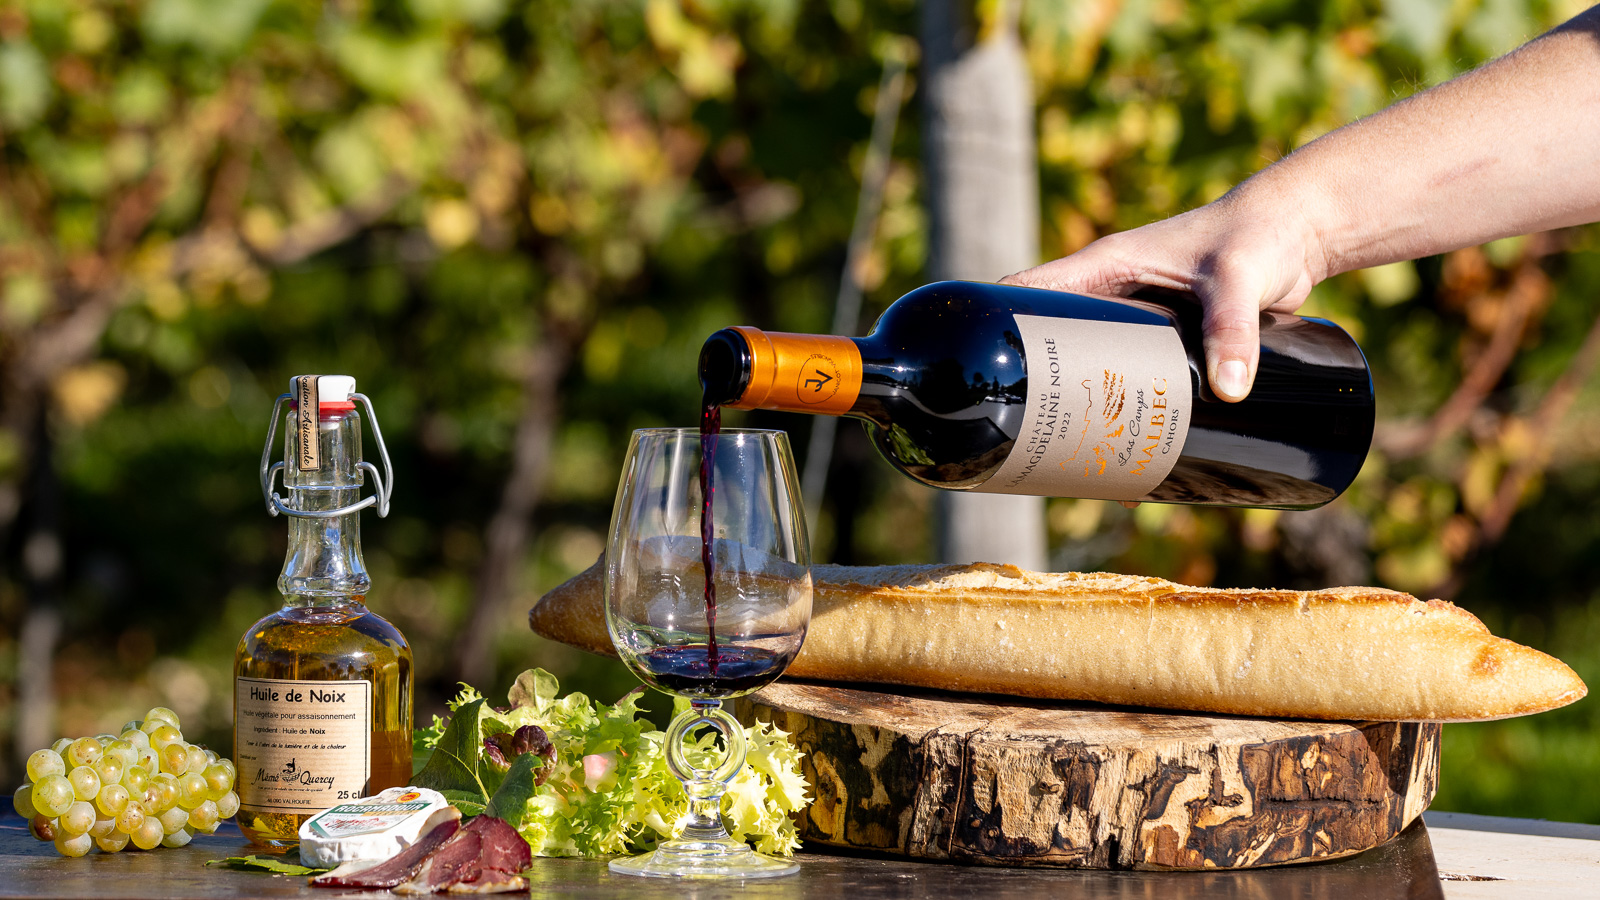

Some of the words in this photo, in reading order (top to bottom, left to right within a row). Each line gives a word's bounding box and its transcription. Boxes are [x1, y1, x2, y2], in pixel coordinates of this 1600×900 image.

[1004, 391, 1061, 488] LAMAGDELAINE
[1044, 337, 1061, 387] NOIRE
[1026, 393, 1048, 453] CHÂTEAU
[1057, 412, 1072, 440] 2022
[1129, 388, 1149, 437] Camps
[1129, 377, 1168, 476] MALBEC
[302, 410, 315, 466] Artisanale
[1161, 408, 1179, 455] CAHORS
[250, 686, 279, 702] Huile
[285, 688, 303, 702] de
[309, 689, 346, 703] Noix
[255, 710, 279, 720] végétale
[280, 713, 296, 721] pour
[282, 727, 298, 735] Huile
[300, 770, 335, 790] Quercy
[334, 803, 424, 813] ROCAMADOUR
[337, 790, 349, 800] 25
[351, 790, 361, 800] cl
